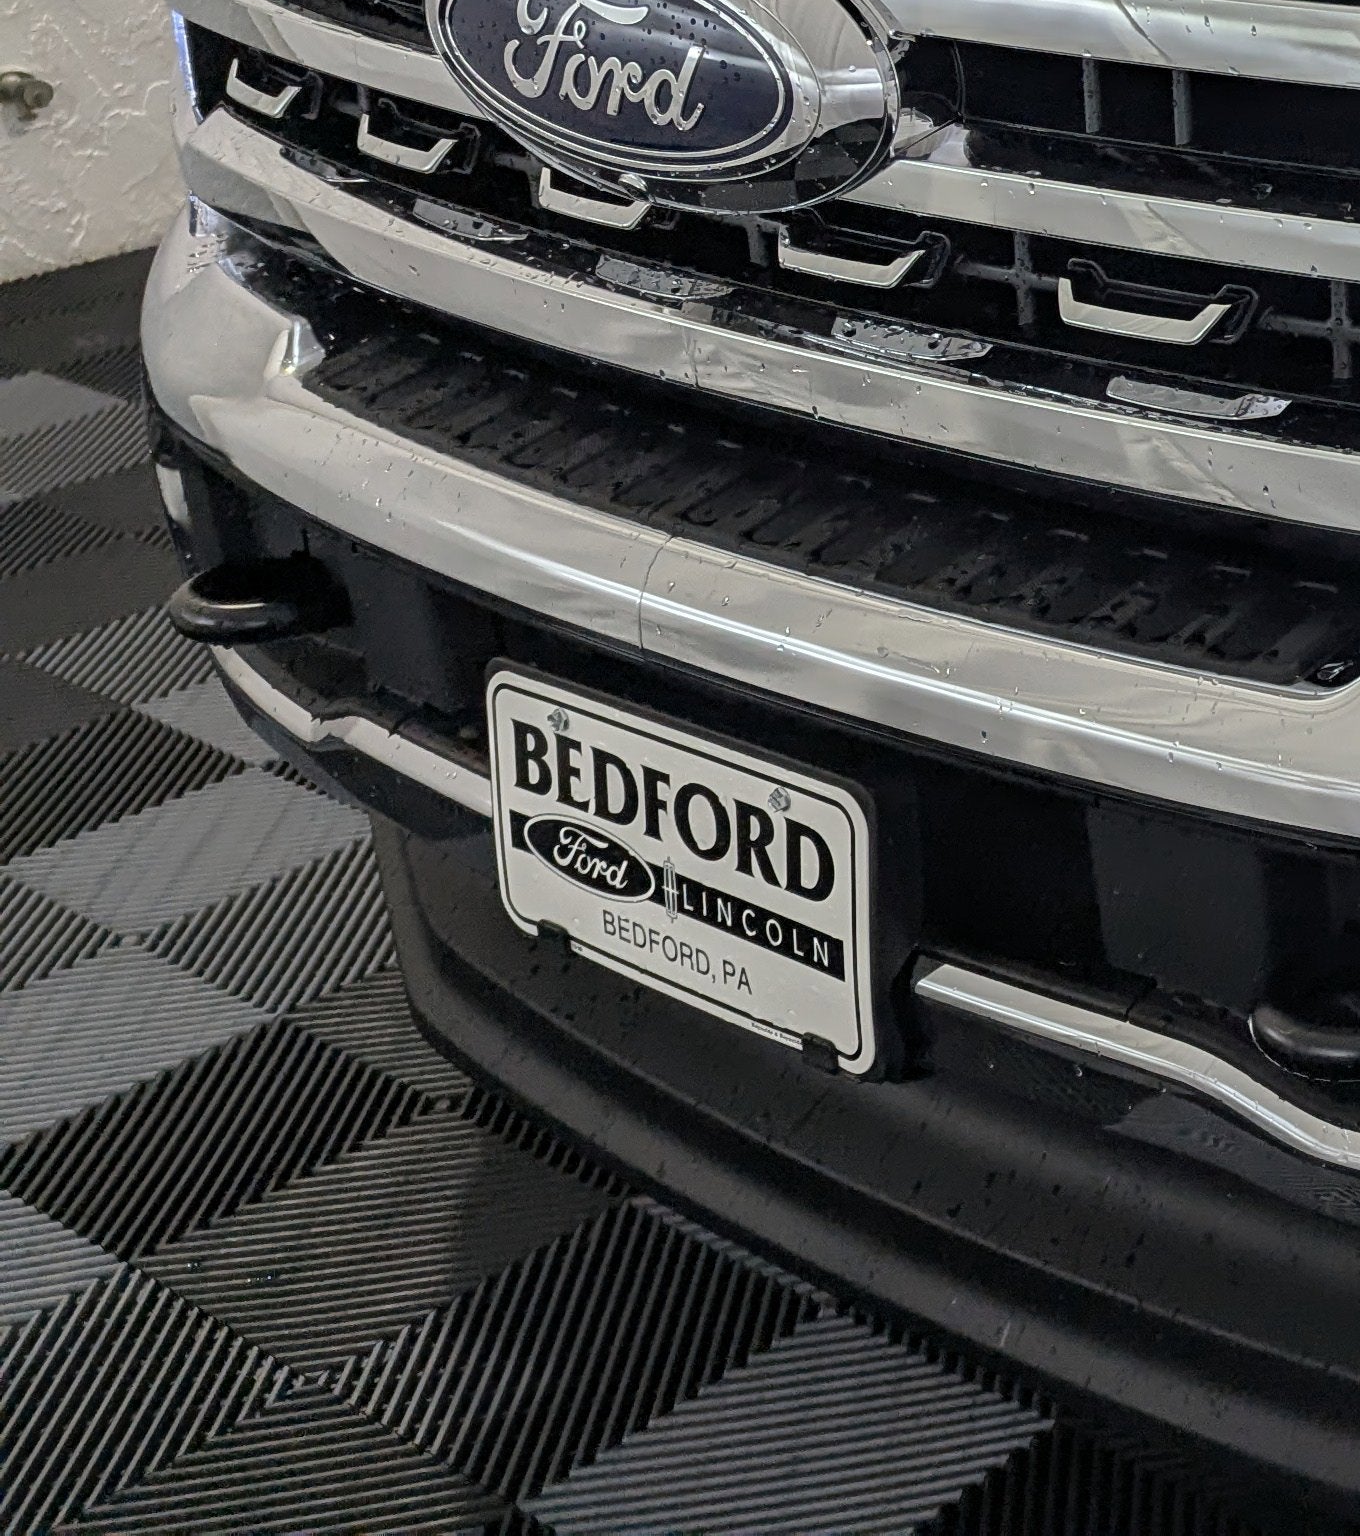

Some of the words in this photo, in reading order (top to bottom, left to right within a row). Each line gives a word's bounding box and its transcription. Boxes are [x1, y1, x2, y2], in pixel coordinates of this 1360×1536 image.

[510, 717, 837, 904] BEDFORD
[552, 824, 630, 892] Ford
[602, 908, 718, 984] BEDFORD,
[722, 957, 754, 996] PA
[682, 877, 831, 968] LINCOLN
